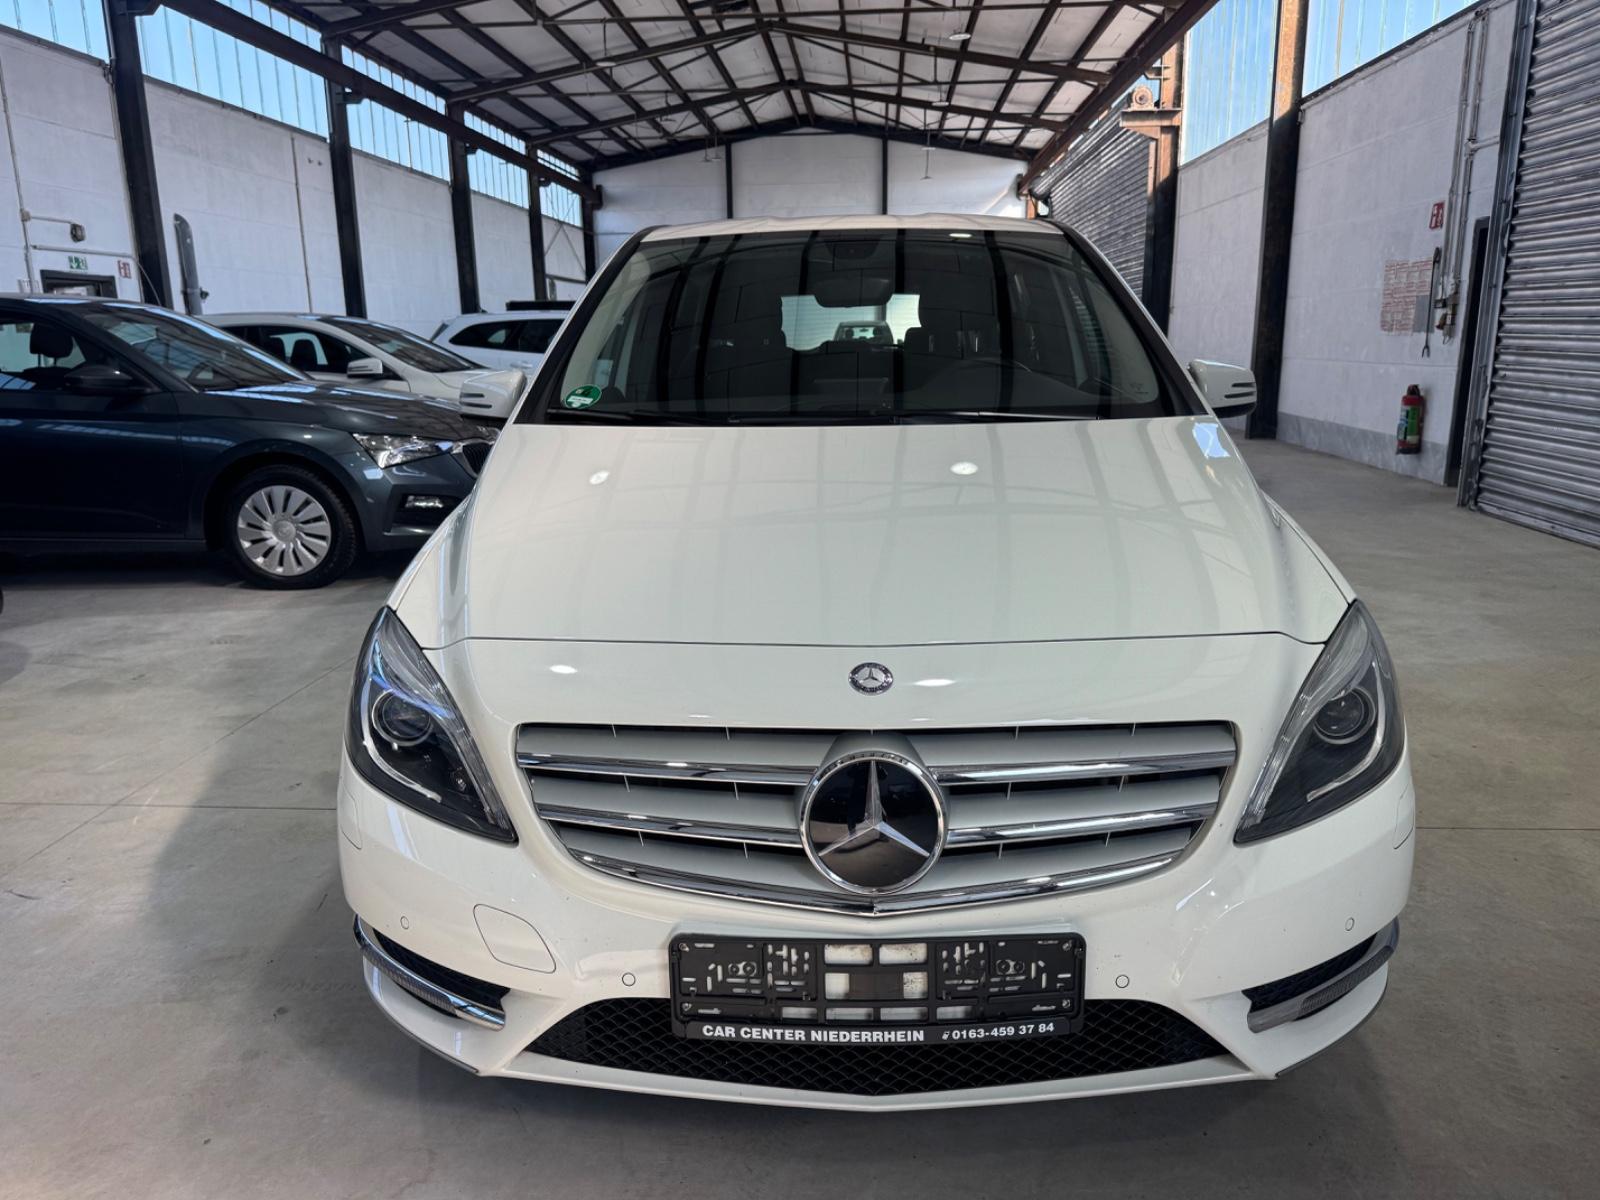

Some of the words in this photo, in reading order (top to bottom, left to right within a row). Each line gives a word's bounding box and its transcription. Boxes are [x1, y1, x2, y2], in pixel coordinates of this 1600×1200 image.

[702, 1024, 736, 1038] CAR
[740, 1027, 806, 1041] CENTER
[810, 1030, 925, 1043] NIEDERRHEIN
[951, 1026, 1015, 1040] 0163-459
[1018, 1024, 1035, 1035] 37
[1038, 1022, 1055, 1033] 84
